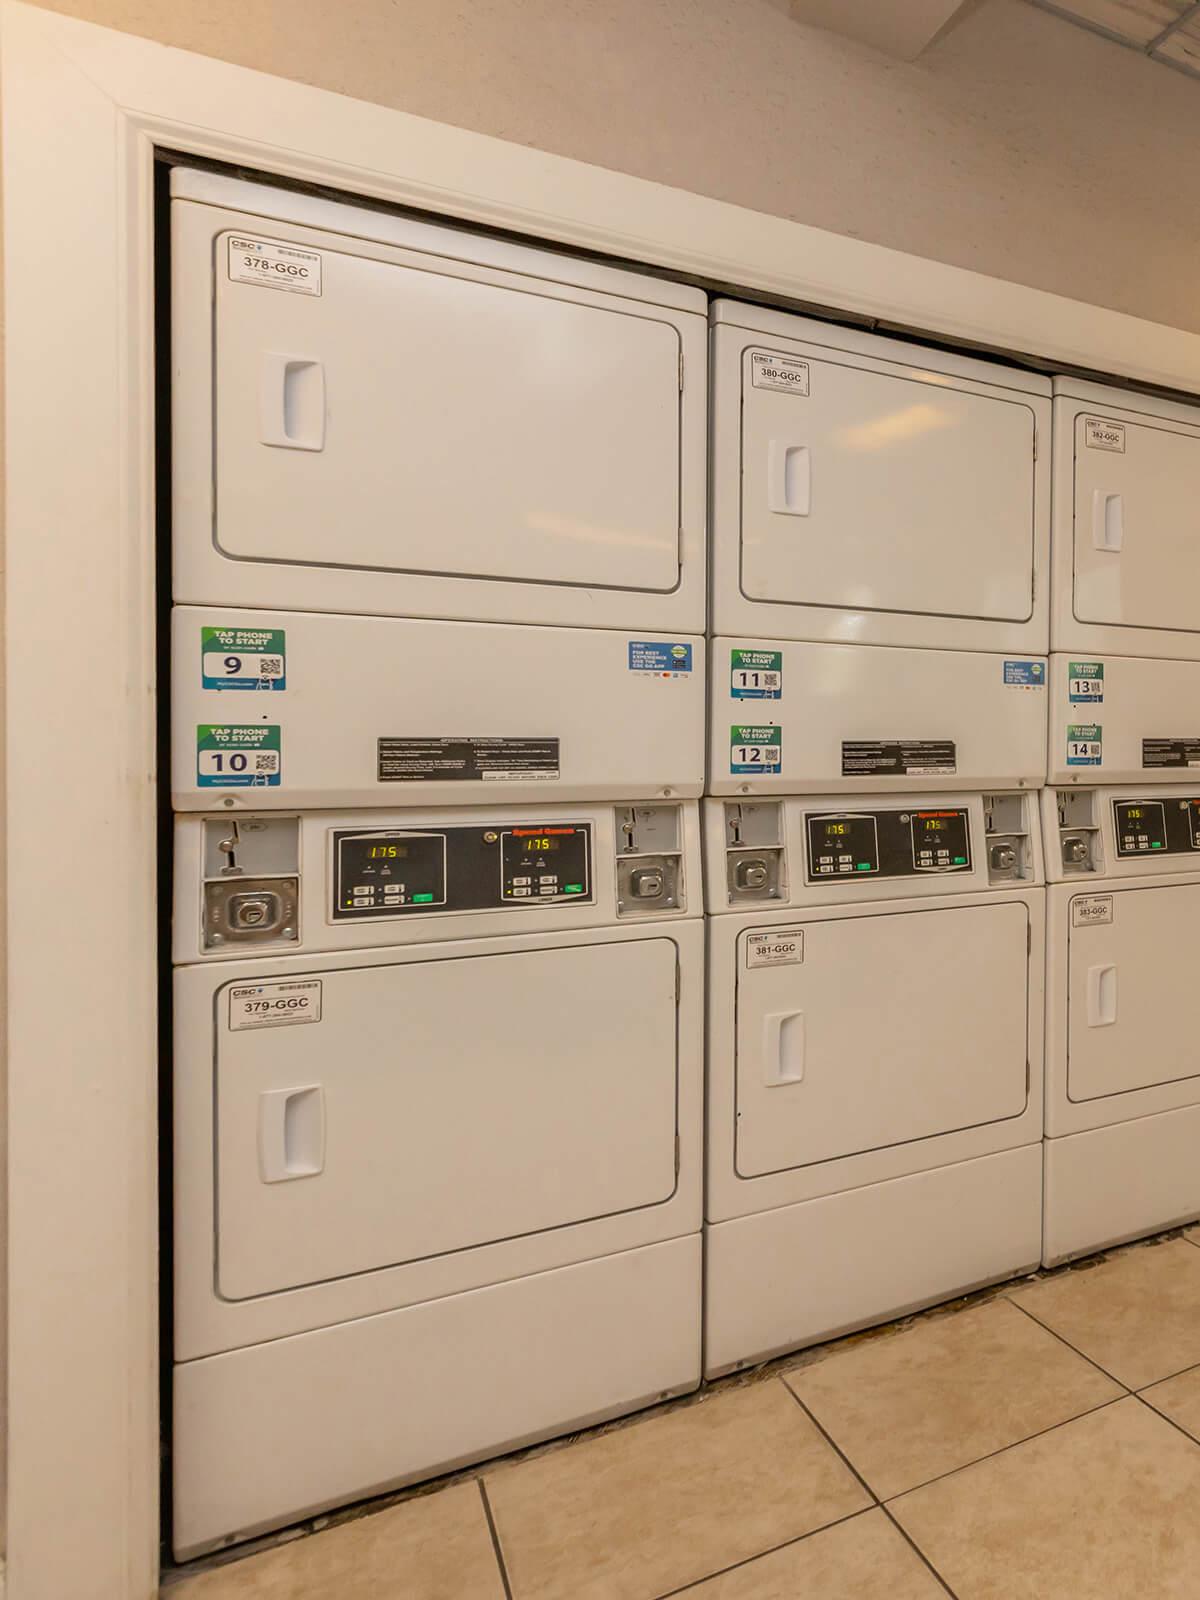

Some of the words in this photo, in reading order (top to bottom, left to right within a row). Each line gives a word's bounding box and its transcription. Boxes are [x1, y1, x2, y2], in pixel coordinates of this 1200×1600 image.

[232, 240, 255, 249] CSC
[244, 257, 309, 278] 378-GGC
[761, 368, 801, 382] 380-GGC
[224, 656, 242, 674] 9
[740, 672, 759, 687] 11
[1075, 681, 1090, 693] 13
[739, 748, 760, 762] 12
[1073, 744, 1088, 755] 14
[211, 753, 247, 772] 10
[1127, 810, 1140, 818] 175
[827, 823, 845, 835] 175
[927, 820, 941, 829] 175
[528, 839, 550, 850] 175
[371, 847, 397, 858] 175
[756, 944, 796, 955] 381-GGC
[244, 997, 309, 1013] 379-GGC
